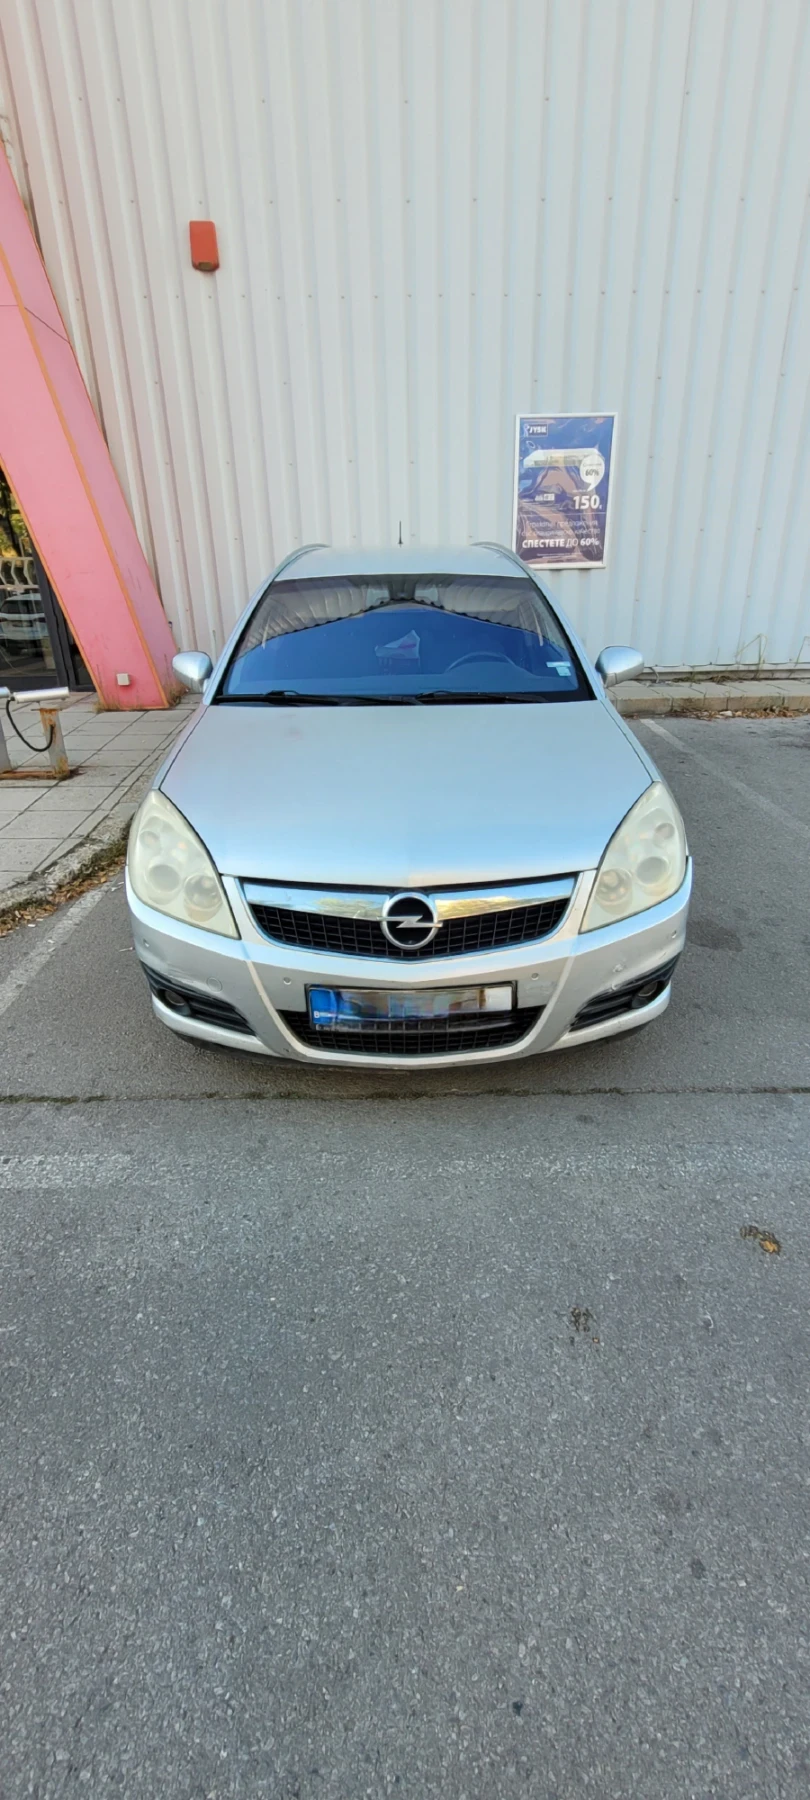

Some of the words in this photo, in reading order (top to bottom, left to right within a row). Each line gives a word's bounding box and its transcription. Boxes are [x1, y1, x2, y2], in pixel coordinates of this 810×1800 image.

[529, 426, 547, 434] JYSK
[585, 469, 600, 477] 60%
[522, 539, 565, 548] СПЕСТЕТЕ
[566, 538, 579, 548] ДО
[580, 537, 600, 546] 60%
